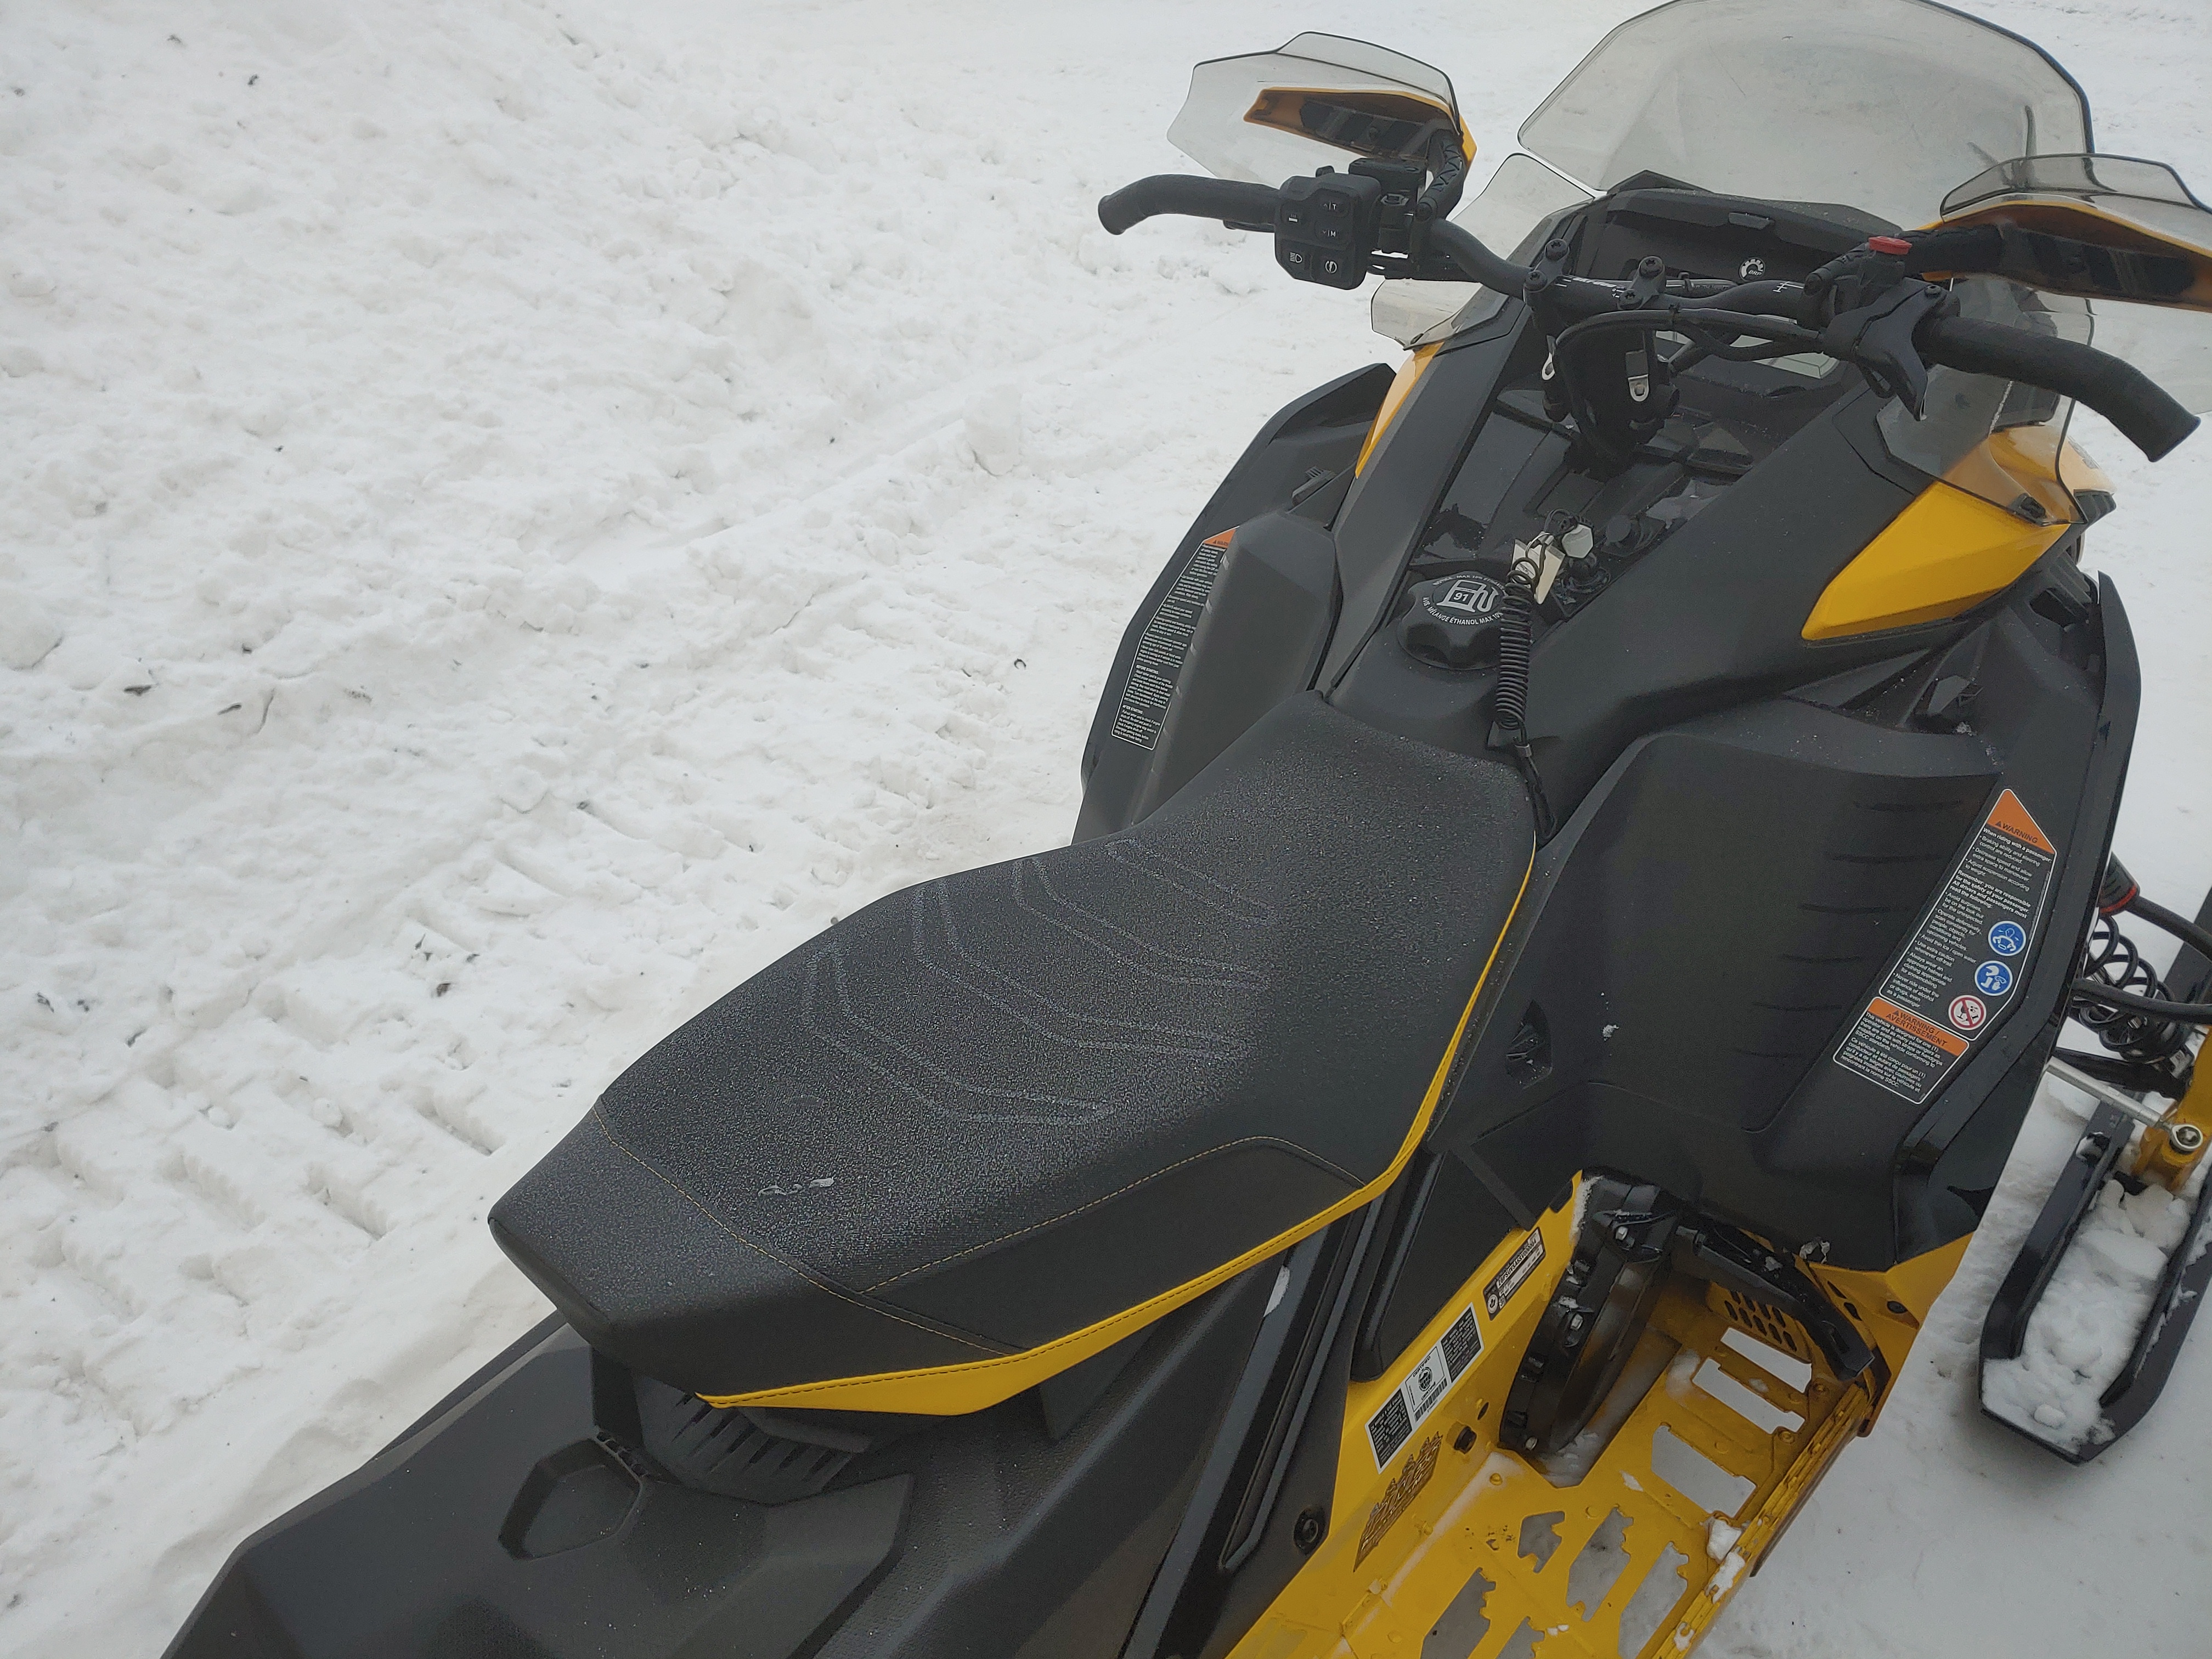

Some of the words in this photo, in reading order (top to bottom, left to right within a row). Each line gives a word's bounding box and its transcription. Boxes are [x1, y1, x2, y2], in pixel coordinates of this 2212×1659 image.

[1454, 592, 1469, 601] 91
[1426, 607, 1451, 622] MÉLANGE
[1449, 617, 1479, 625] ÉTHANOL
[2002, 823, 2038, 843] WARNING
[1885, 1013, 1948, 1047] AVERTISSEMENT
[1900, 1012, 1935, 1034] WARNING
